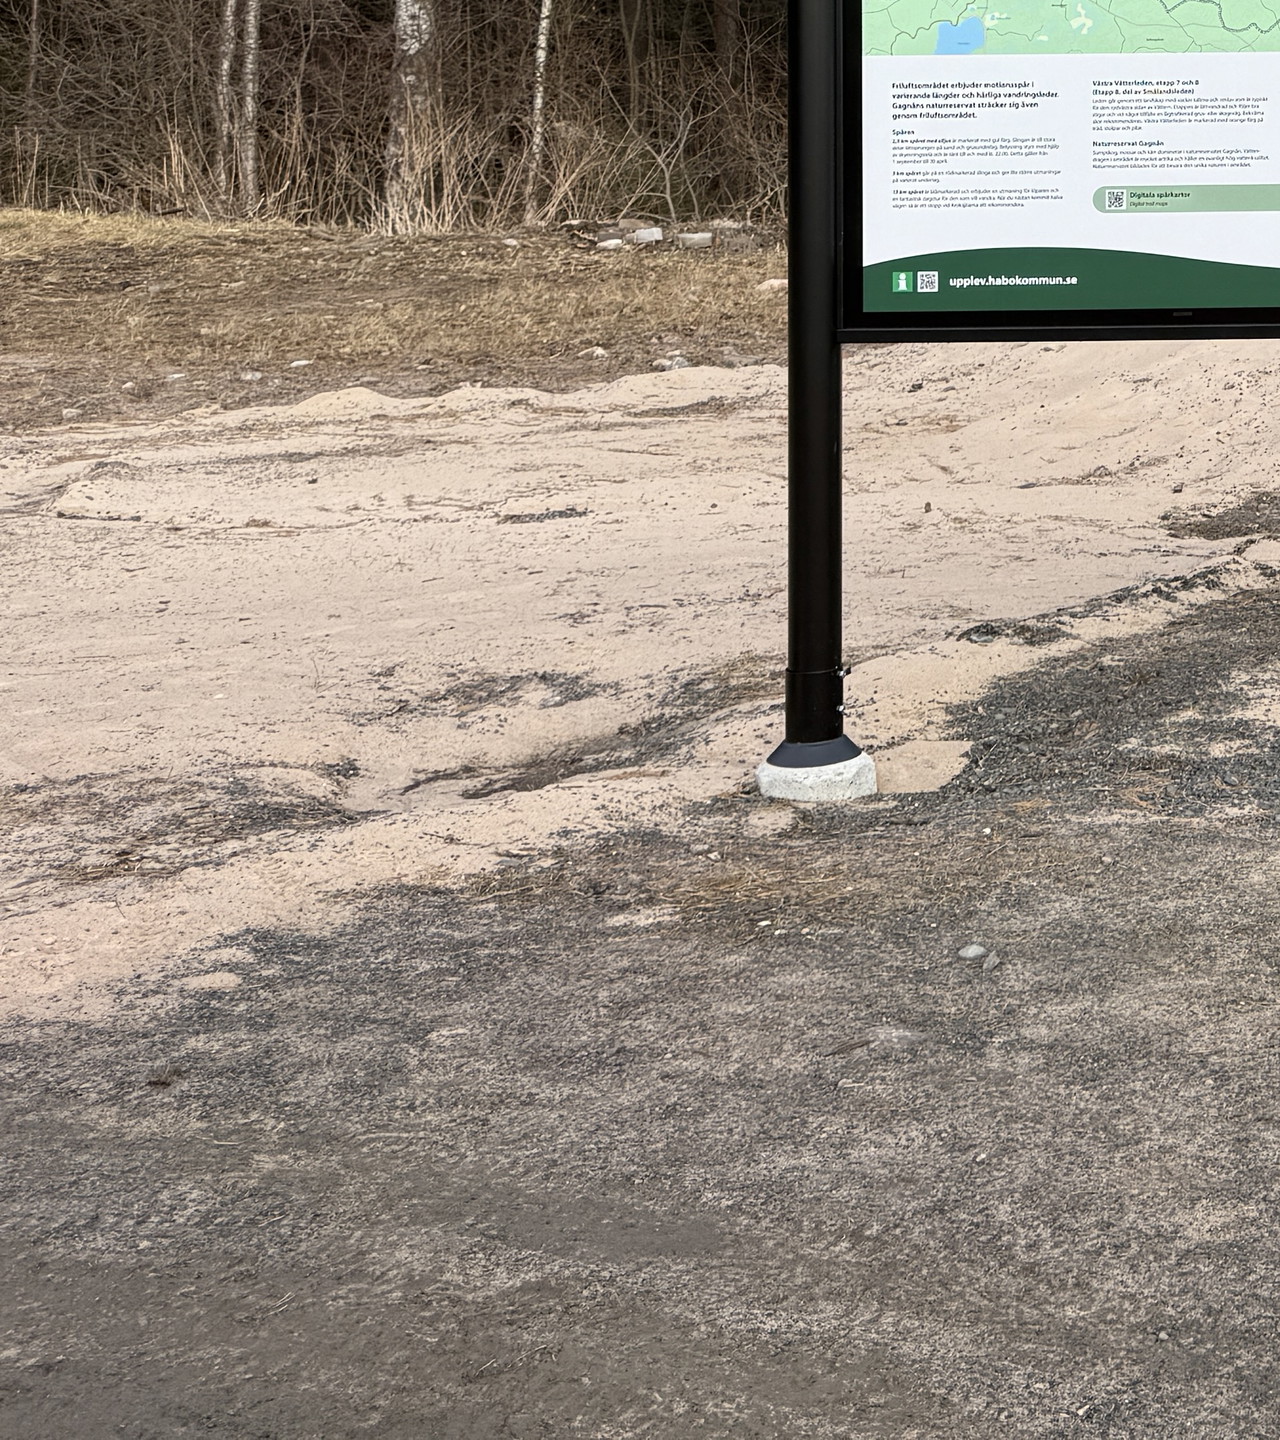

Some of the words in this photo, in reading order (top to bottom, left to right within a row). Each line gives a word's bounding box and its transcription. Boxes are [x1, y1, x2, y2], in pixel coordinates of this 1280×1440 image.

[950, 81, 982, 89] erbjuder
[931, 92, 960, 100] längder
[976, 91, 1001, 99] härliga
[892, 102, 924, 110] Gagnåns
[1008, 101, 1019, 109] sig
[1129, 191, 1155, 199] Digitala
[949, 274, 1078, 288] upplev.habokommun.se
